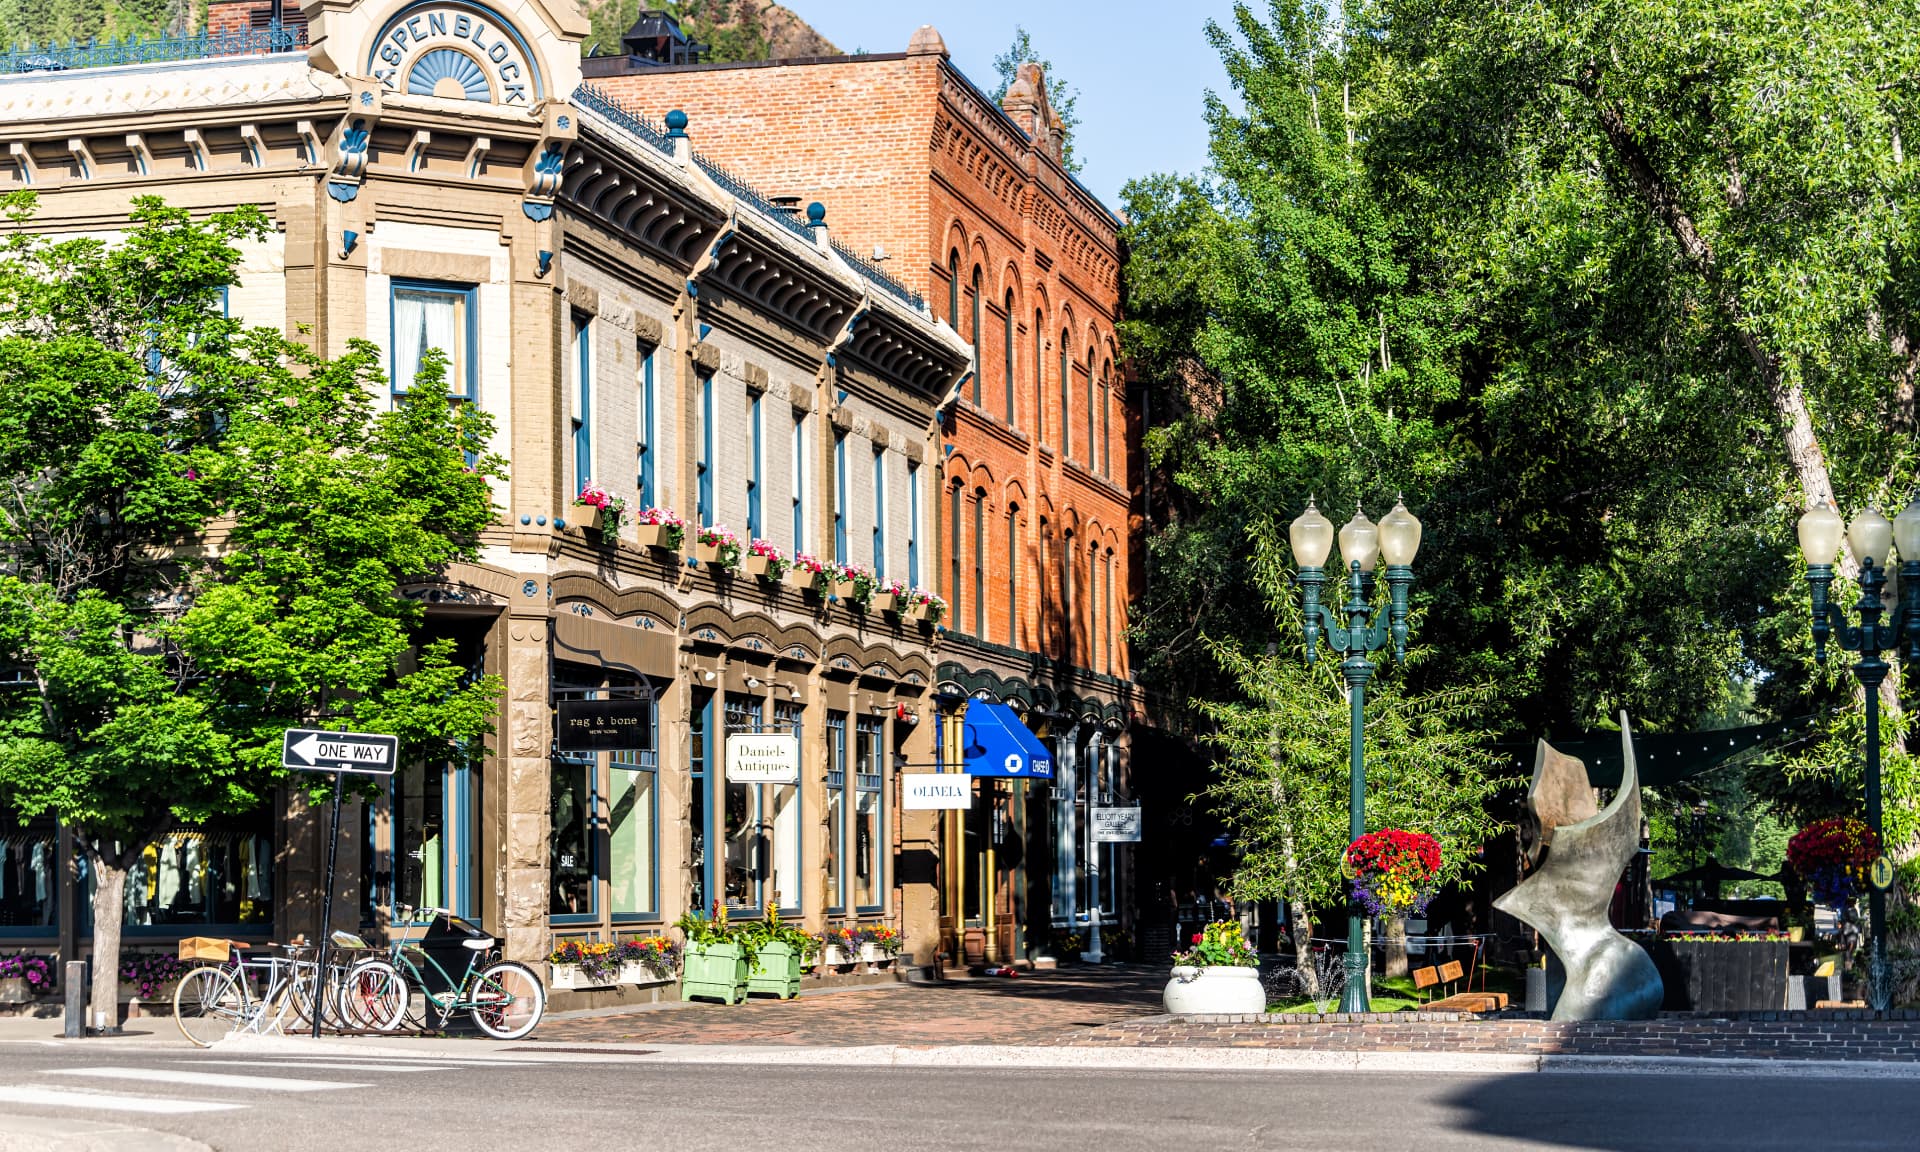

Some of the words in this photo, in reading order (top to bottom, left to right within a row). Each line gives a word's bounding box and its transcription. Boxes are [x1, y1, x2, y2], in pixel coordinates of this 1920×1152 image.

[375, 12, 447, 89] ASPEN
[453, 14, 526, 103] BLOCK
[569, 718, 590, 728] rag
[596, 716, 604, 726] &
[610, 716, 638, 726] bone
[318, 743, 348, 758] ONE
[353, 745, 384, 761] WAY
[740, 745, 785, 757] Daniels
[735, 760, 790, 775] Antiques
[1032, 759, 1046, 773] CHASE
[913, 786, 962, 797] OLIVELA
[561, 855, 574, 867] SALE
